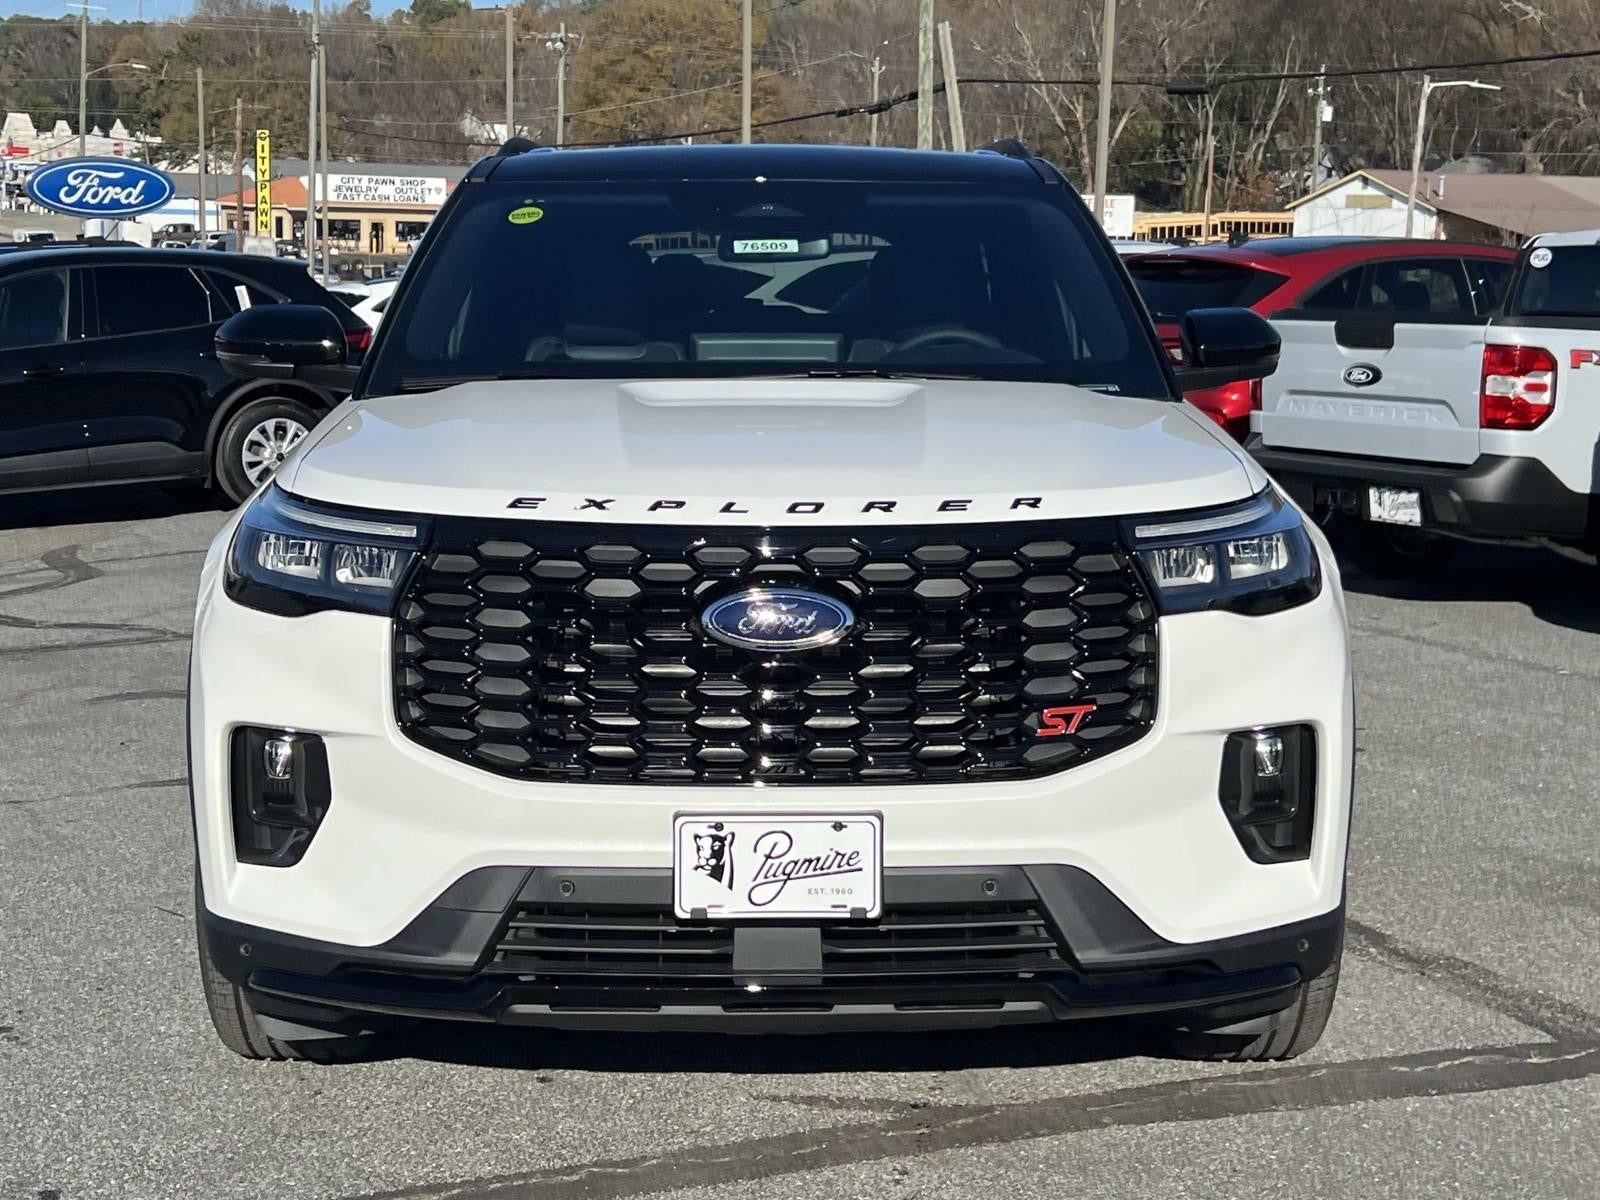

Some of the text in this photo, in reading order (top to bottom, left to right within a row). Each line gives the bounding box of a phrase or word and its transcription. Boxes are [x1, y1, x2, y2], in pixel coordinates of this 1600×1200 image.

[58, 168, 148, 205] Ford
[258, 131, 269, 230] CITY PAWN
[332, 185, 433, 196] JEWELRY OUTLET
[340, 176, 426, 187] CITY PAWN SHOP
[336, 193, 426, 203] FAST CASH LOANS
[740, 242, 788, 251] 76509
[1287, 399, 1442, 425] MAVERICK
[506, 496, 1043, 515] EXPLORER
[736, 601, 819, 636] Ford
[1035, 704, 1097, 737] ST
[747, 829, 864, 907] Pugmire
[807, 887, 854, 895] EST. 1960
